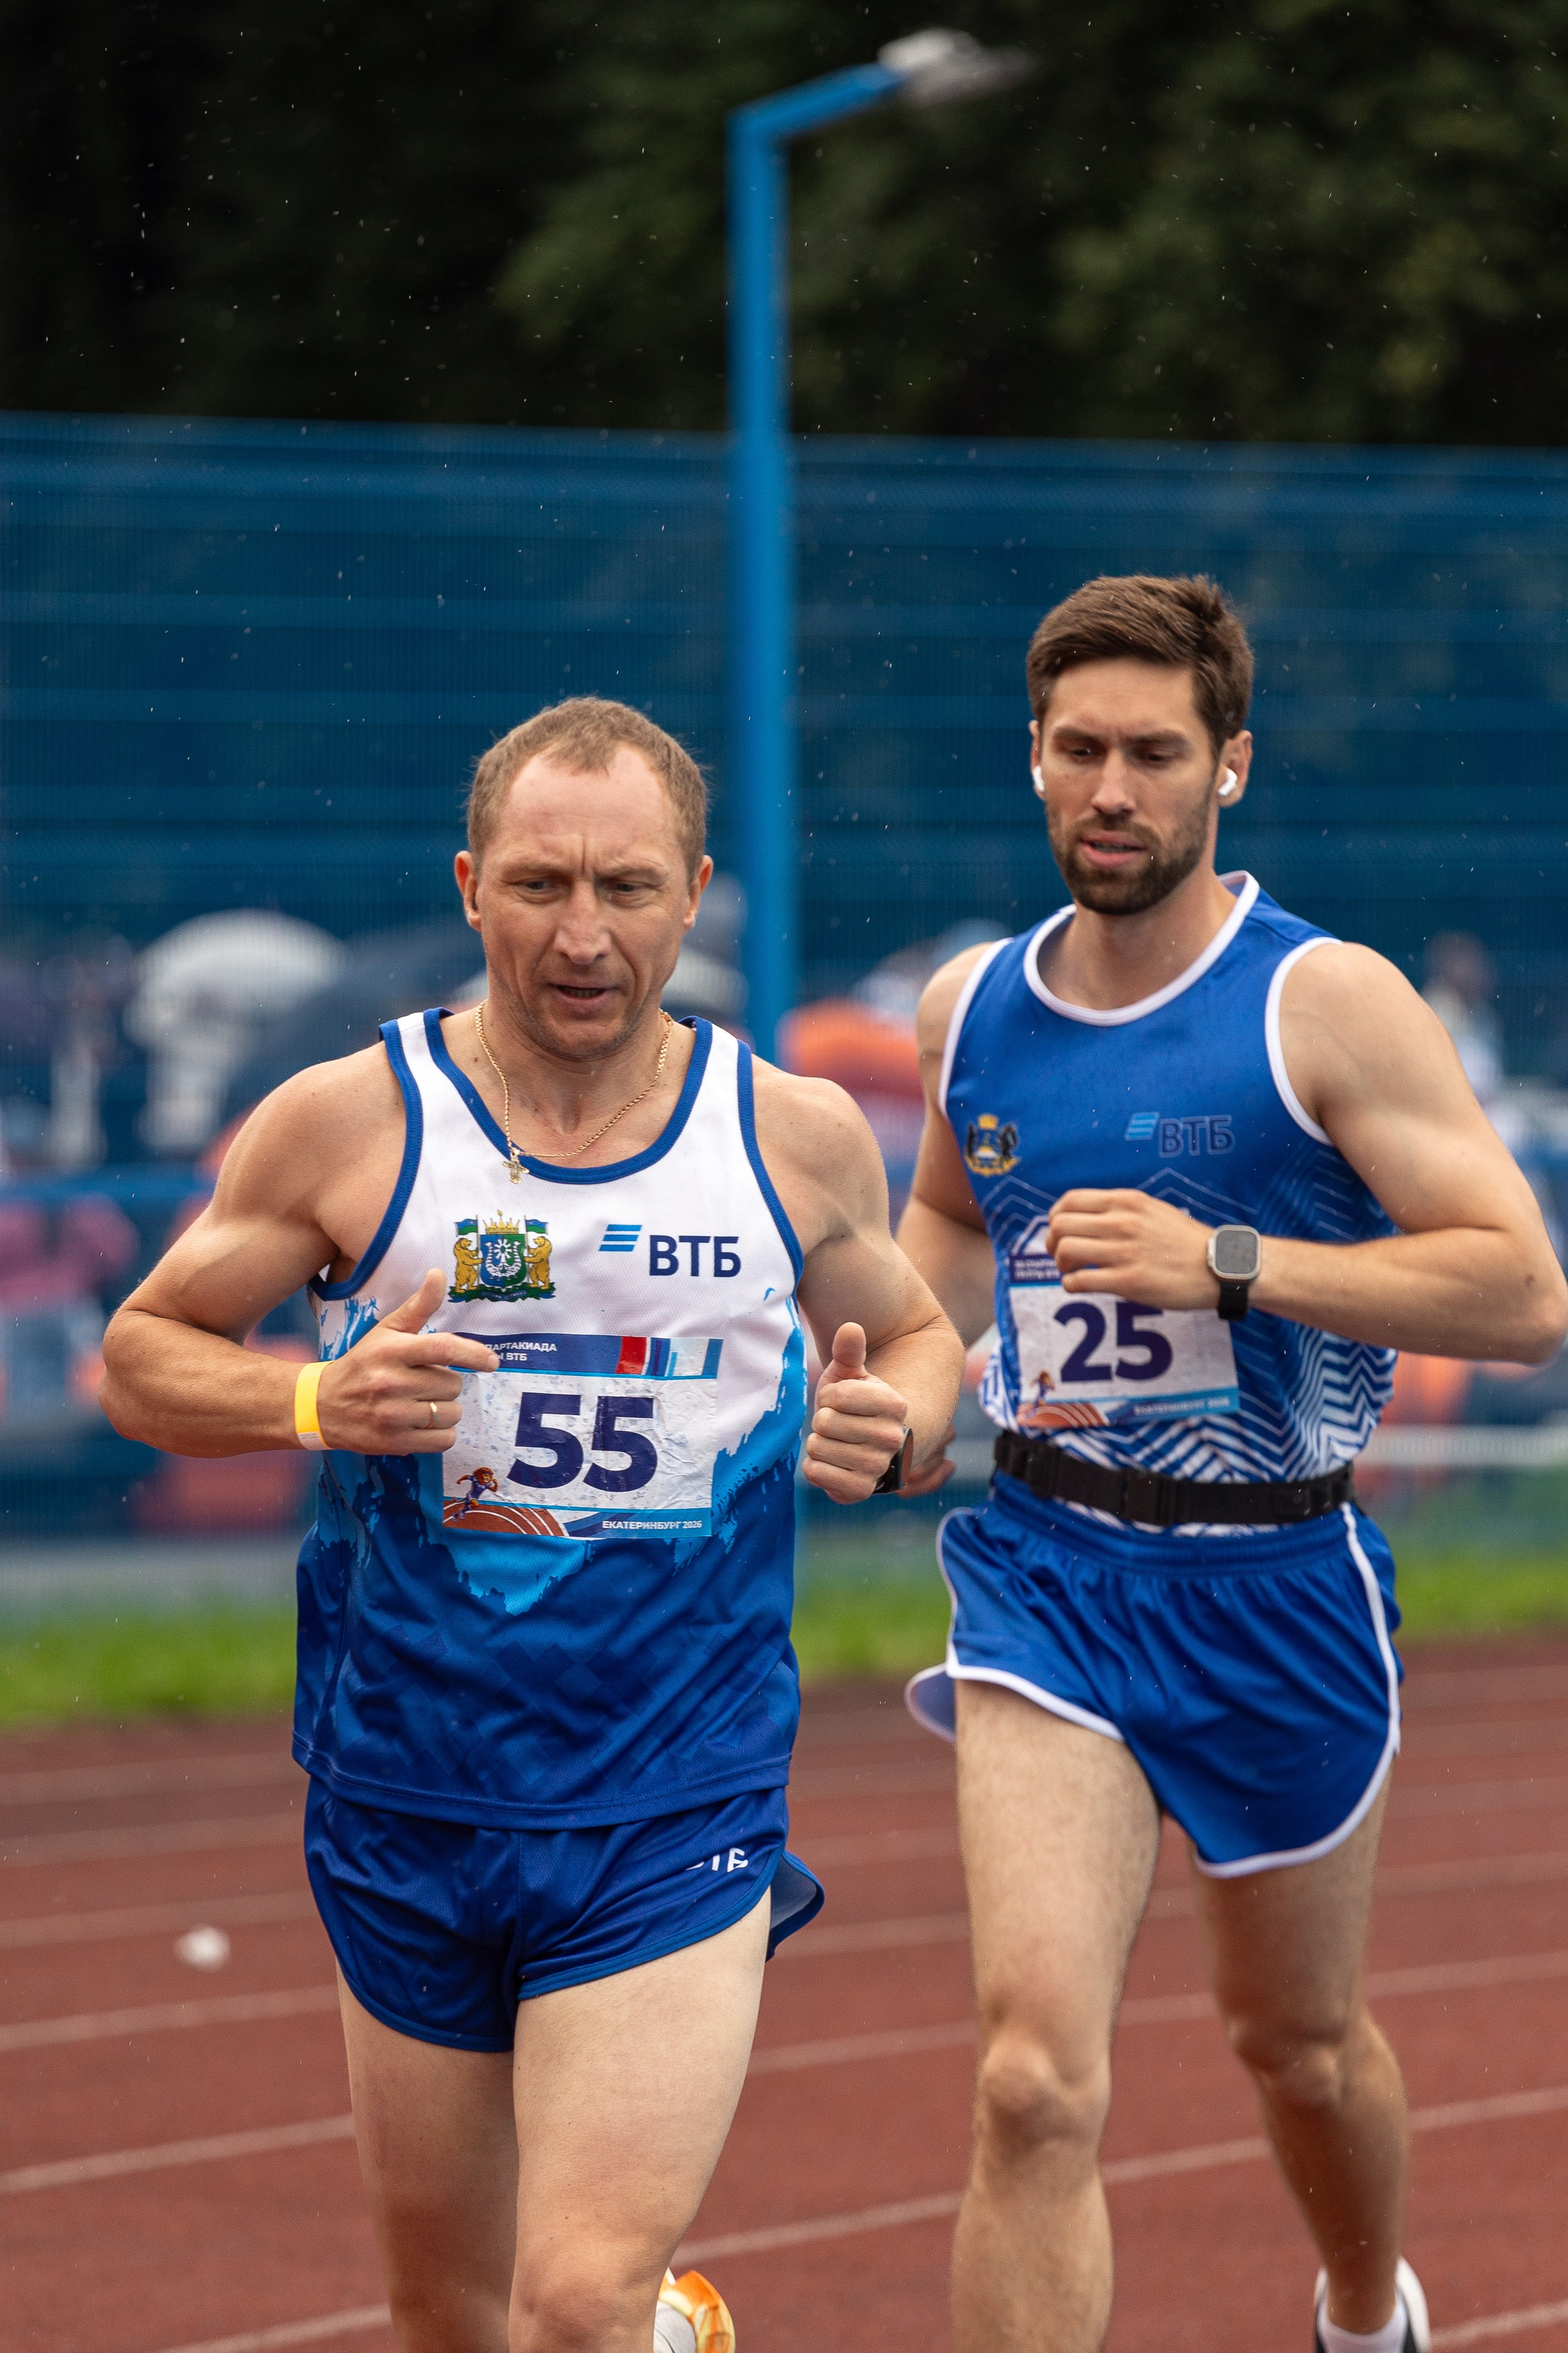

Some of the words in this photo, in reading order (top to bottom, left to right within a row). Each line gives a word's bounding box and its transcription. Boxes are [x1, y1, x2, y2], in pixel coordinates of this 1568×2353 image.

[1159, 1114, 1235, 1158] ВТБ
[649, 1234, 741, 1278] ВТБ
[485, 1342, 557, 1352] ПАРТАКИАДА
[506, 1353, 527, 1361] ВТБ
[1053, 1301, 1172, 1383] 25
[507, 1392, 658, 1492] 55
[602, 1520, 681, 1530] ЕКАТЕРИНБУРГ
